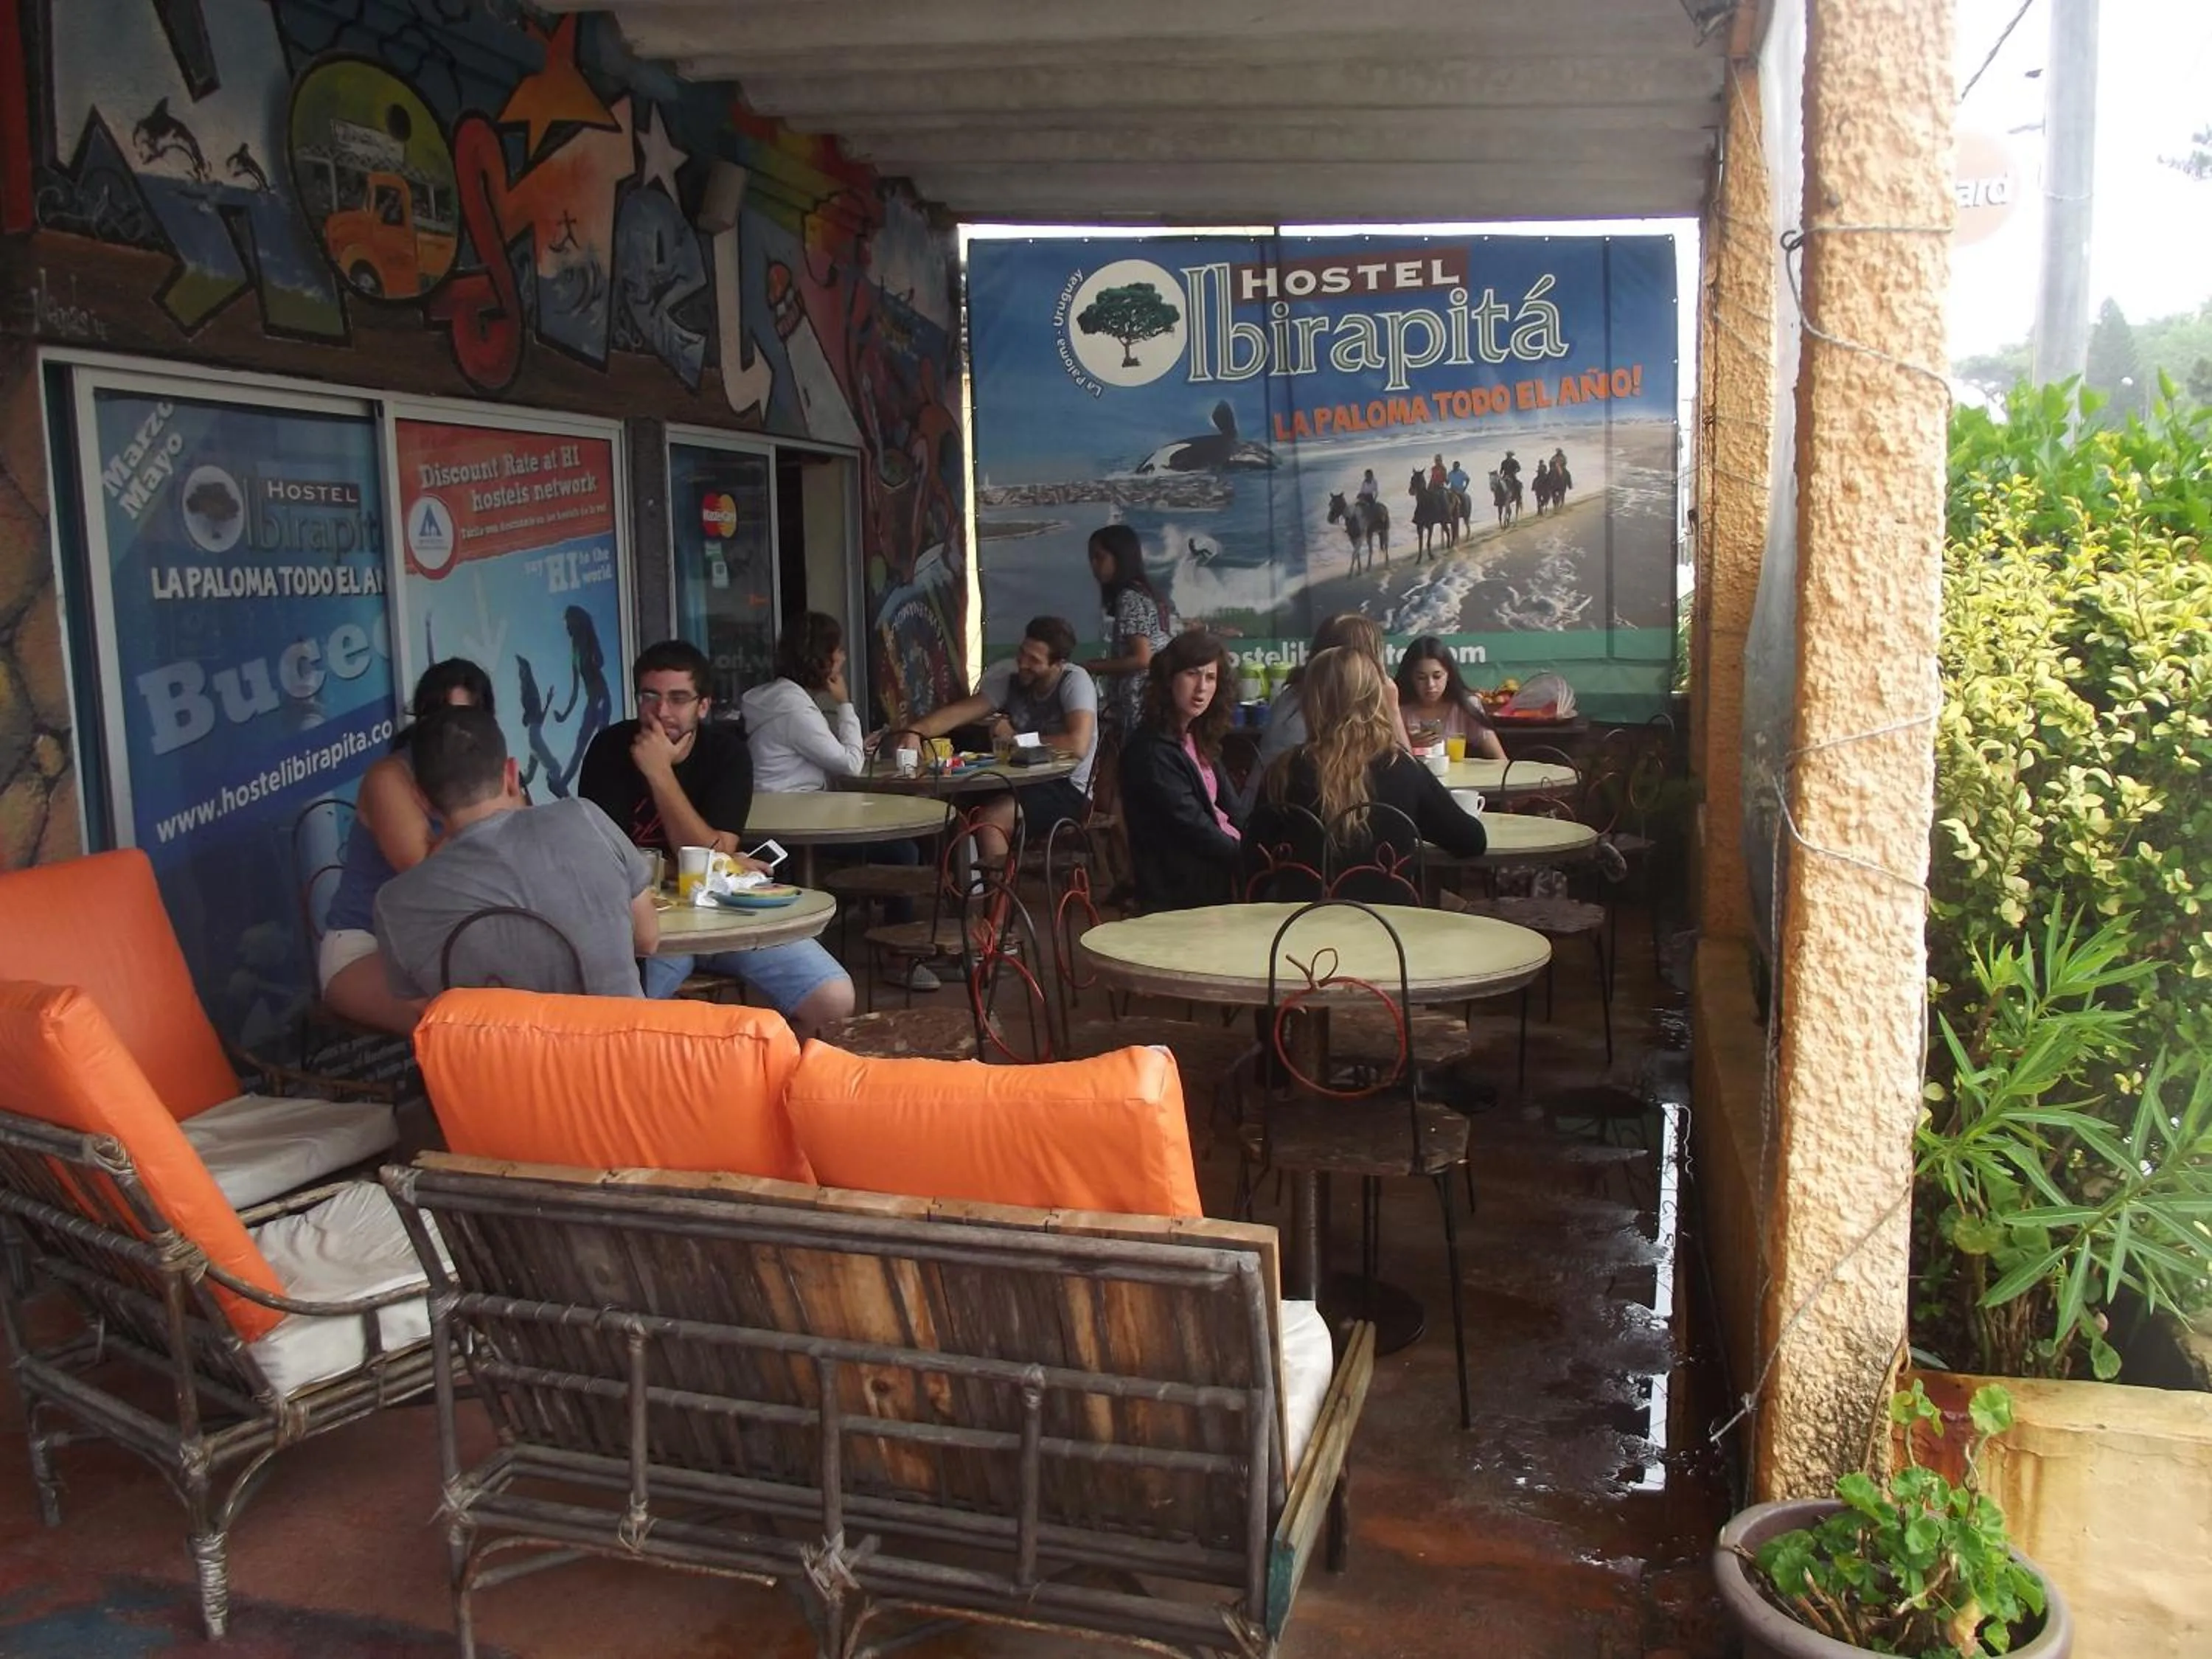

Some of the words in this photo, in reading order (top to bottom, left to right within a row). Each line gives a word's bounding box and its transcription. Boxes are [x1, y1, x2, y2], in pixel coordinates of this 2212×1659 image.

[1954, 171, 2008, 208] ard
[1054, 268, 1084, 327] Uruguay
[1240, 259, 1460, 299] HOSTEL
[1180, 262, 1569, 392] Ibirapitá
[1057, 339, 1087, 386] Paloma
[1086, 382, 1102, 397] La
[1273, 412, 1307, 442] LA
[1315, 396, 1433, 433] PALOMA
[1433, 383, 1511, 420] TODO
[1515, 378, 1551, 411] EL
[1557, 365, 1644, 407] AÑO!
[119, 432, 184, 518] Mayo
[420, 457, 499, 490] Discount
[502, 451, 539, 477] Rate
[543, 449, 558, 470] at
[560, 445, 581, 467] HI
[266, 480, 359, 504] HOSTEL
[471, 482, 531, 512] hostels
[533, 475, 598, 501] network
[243, 476, 382, 563] Ibirapit
[150, 566, 184, 600] LA
[187, 566, 278, 599] PALOMA
[279, 565, 334, 596] TODO
[336, 566, 361, 594] EL
[544, 552, 582, 594] HI
